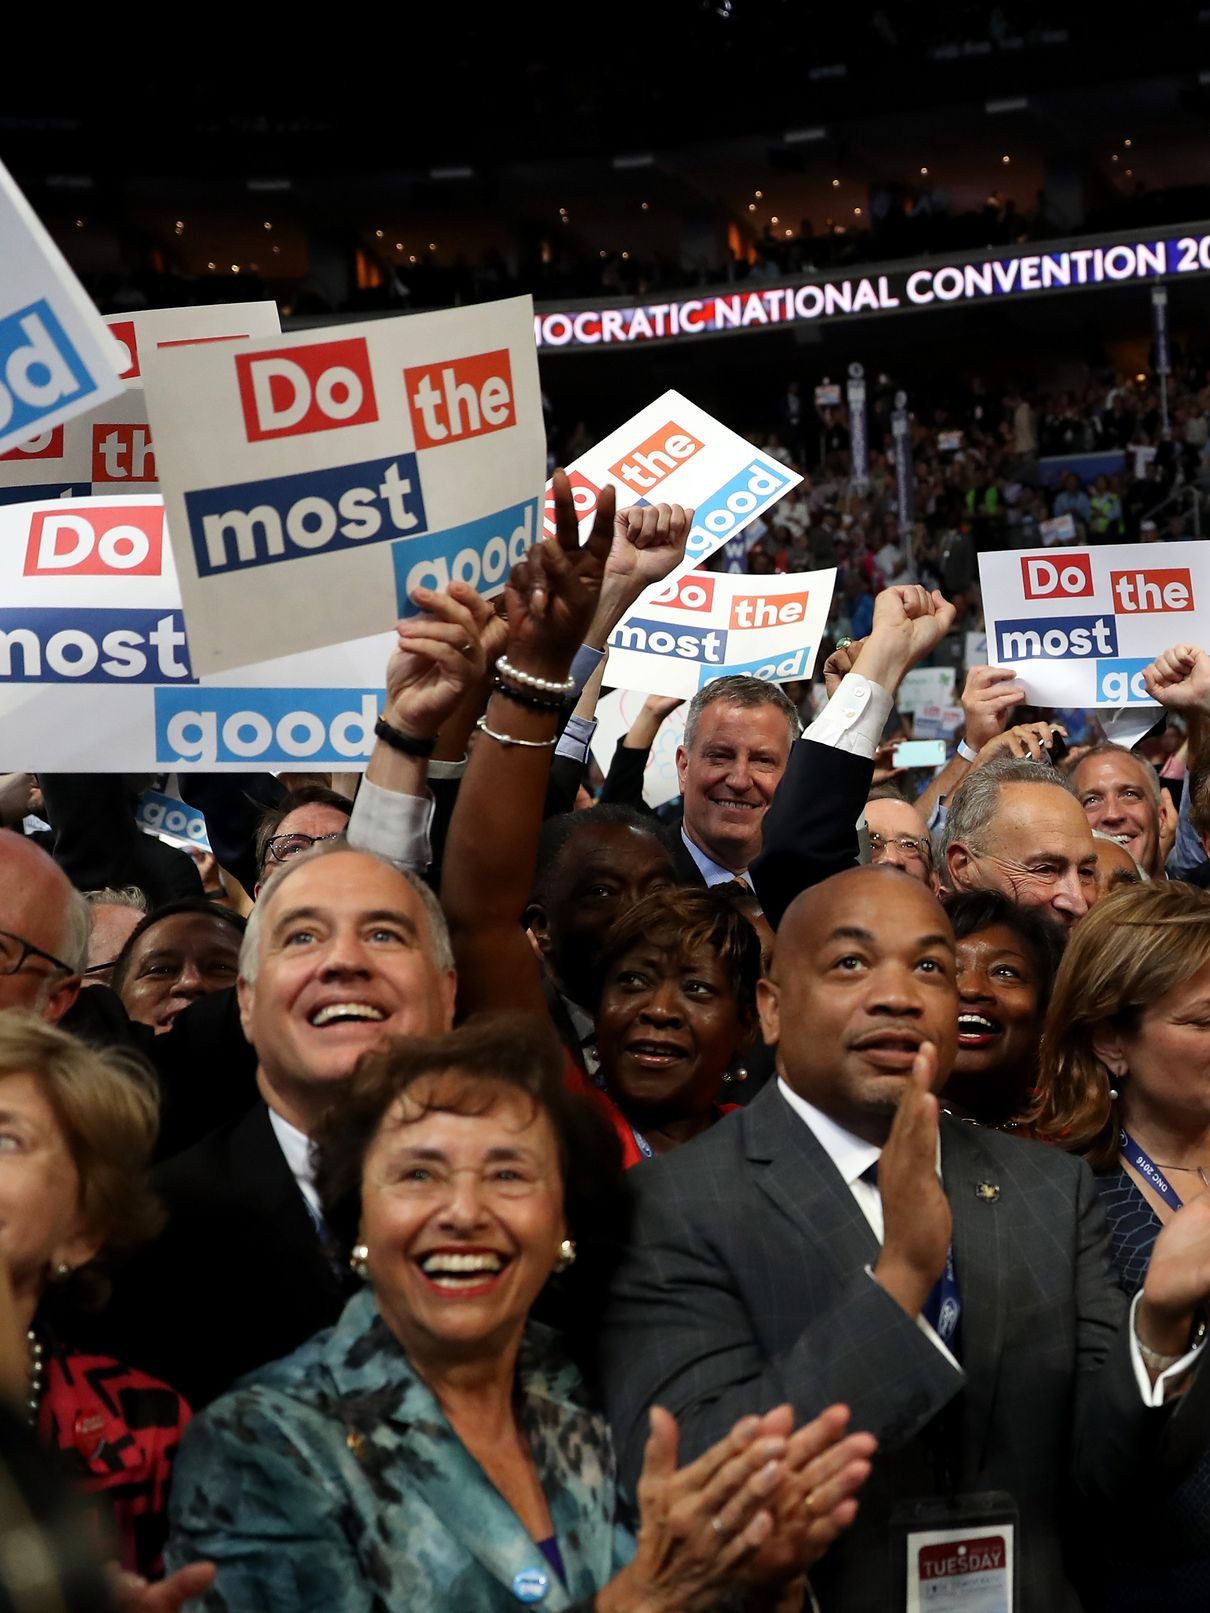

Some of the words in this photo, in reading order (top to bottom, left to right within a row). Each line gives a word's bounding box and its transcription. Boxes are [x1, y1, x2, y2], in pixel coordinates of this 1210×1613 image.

[534, 299, 705, 347] OCRATIC
[714, 276, 899, 328] NATIONAL
[906, 241, 1167, 304] CONVENTION
[250, 358, 364, 433] Do
[414, 367, 511, 442] the
[99, 429, 158, 478] th
[620, 435, 696, 488] the
[202, 462, 419, 568] most
[37, 515, 149, 569] Do
[1028, 561, 1086, 594] Do
[1116, 569, 1189, 611] the
[735, 599, 803, 627] the
[608, 626, 720, 661] most
[1001, 618, 1113, 660] most
[1101, 670, 1147, 701] go
[166, 694, 377, 762] good
[143, 803, 206, 840] goo
[1135, 1156, 1152, 1177] 2016
[1152, 1173, 1168, 1192] DNC
[922, 1551, 1002, 1577] TUESDAY
